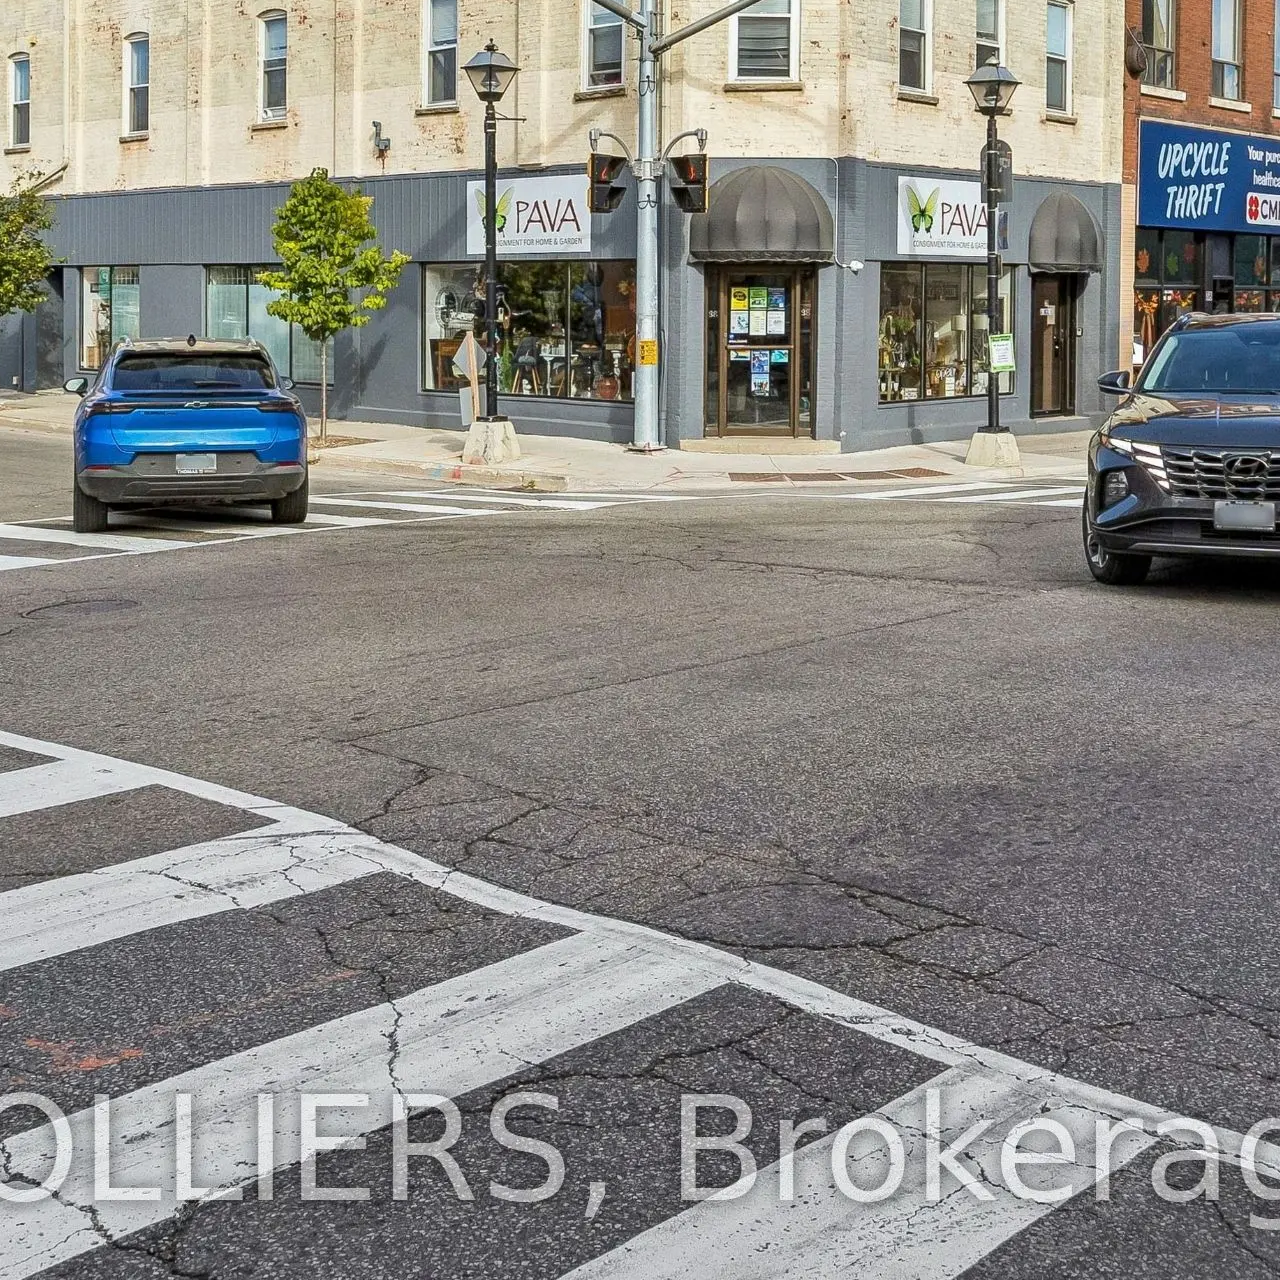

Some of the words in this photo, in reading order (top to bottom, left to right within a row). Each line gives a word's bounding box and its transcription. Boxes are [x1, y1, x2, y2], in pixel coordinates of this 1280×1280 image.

[1157, 141, 1232, 180] UPCYCLE
[1247, 144, 1264, 162] Your
[515, 199, 581, 234] PAVA
[1165, 182, 1226, 220] THRIFT
[941, 202, 988, 236] PAVA
[523, 238, 535, 246] FOR
[535, 238, 553, 246] HOME
[553, 237, 558, 246] &
[559, 237, 583, 245] GARDEN
[912, 240, 947, 248] CONSIGNMENT
